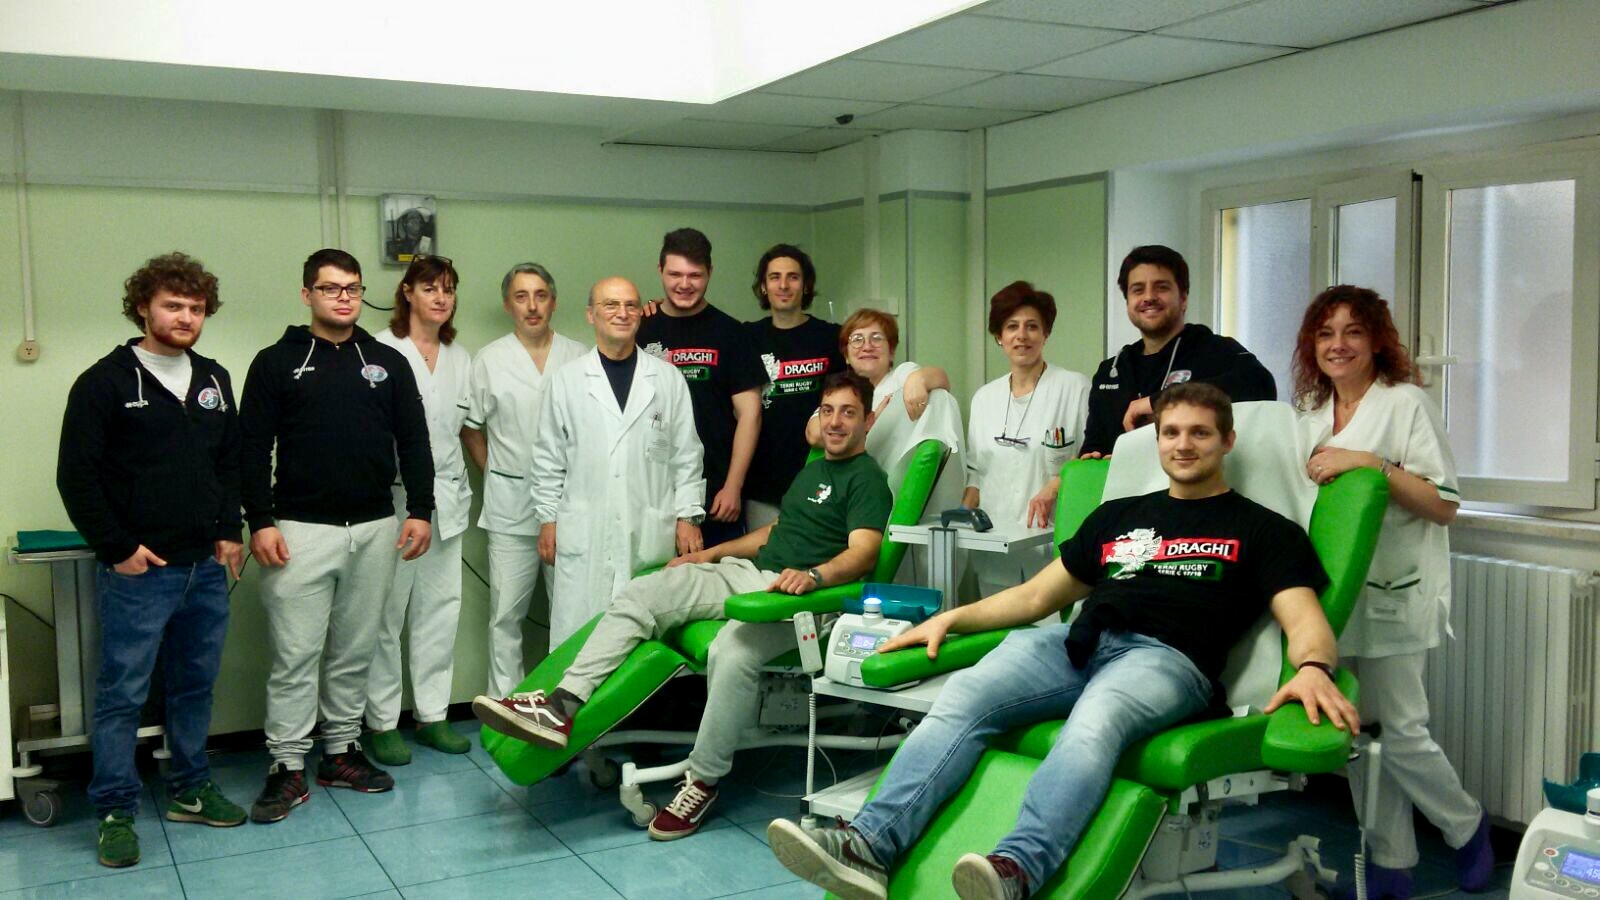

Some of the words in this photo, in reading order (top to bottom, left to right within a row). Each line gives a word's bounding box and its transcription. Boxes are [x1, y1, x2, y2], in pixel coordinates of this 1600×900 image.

[673, 352, 712, 362] DRAGHI
[784, 362, 823, 375] DRAGHI
[1167, 542, 1229, 557] DRAGHI
[1179, 564, 1208, 572] RUGBY
